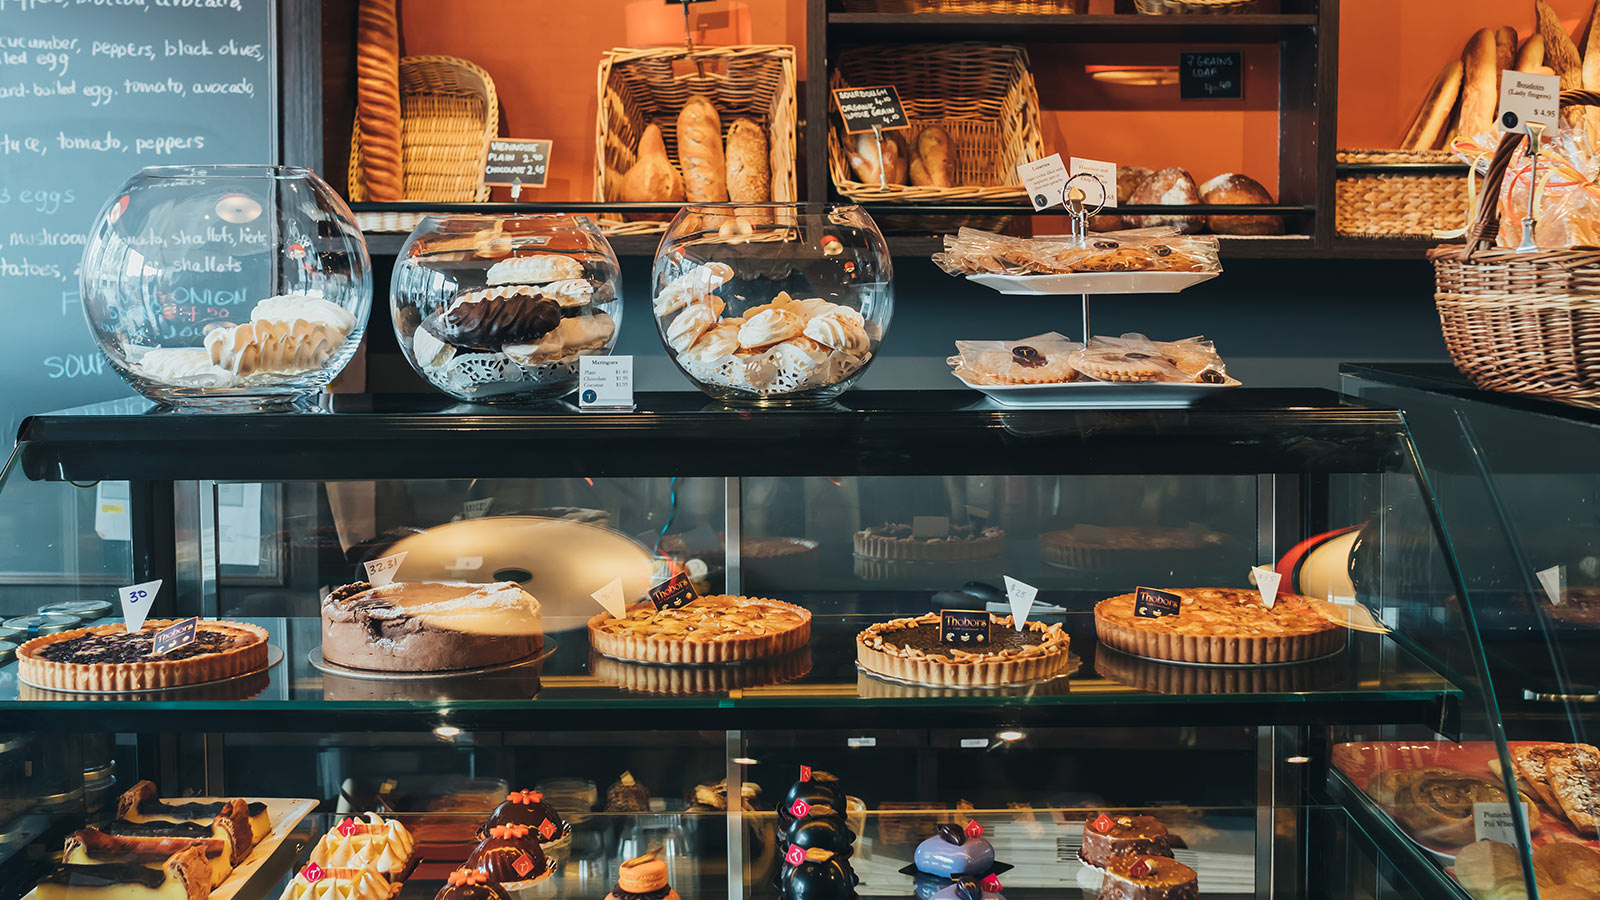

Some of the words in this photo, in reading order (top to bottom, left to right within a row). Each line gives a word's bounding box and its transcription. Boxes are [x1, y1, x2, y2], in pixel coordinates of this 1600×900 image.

[92, 40, 156, 61] peppers,
[165, 39, 213, 57] black
[218, 39, 265, 62] olives,
[0, 51, 27, 64] led
[37, 52, 69, 77] egg
[124, 77, 186, 97] tomato,
[193, 77, 255, 99] avocado,
[871, 107, 895, 117] GRAIN
[56, 131, 129, 152] tomato,
[136, 136, 205, 154] peppers
[487, 153, 516, 161] PLAIN
[20, 189, 75, 214] eggs
[171, 225, 237, 247] shallots,
[173, 255, 242, 273] shallots
[172, 286, 247, 305] ONION
[44, 352, 105, 378] SOUP
[129, 590, 148, 603] 30
[653, 579, 688, 601] Thobors
[1140, 591, 1178, 608] Thobors
[945, 615, 987, 627] Thobors
[158, 623, 194, 643] Thobors
